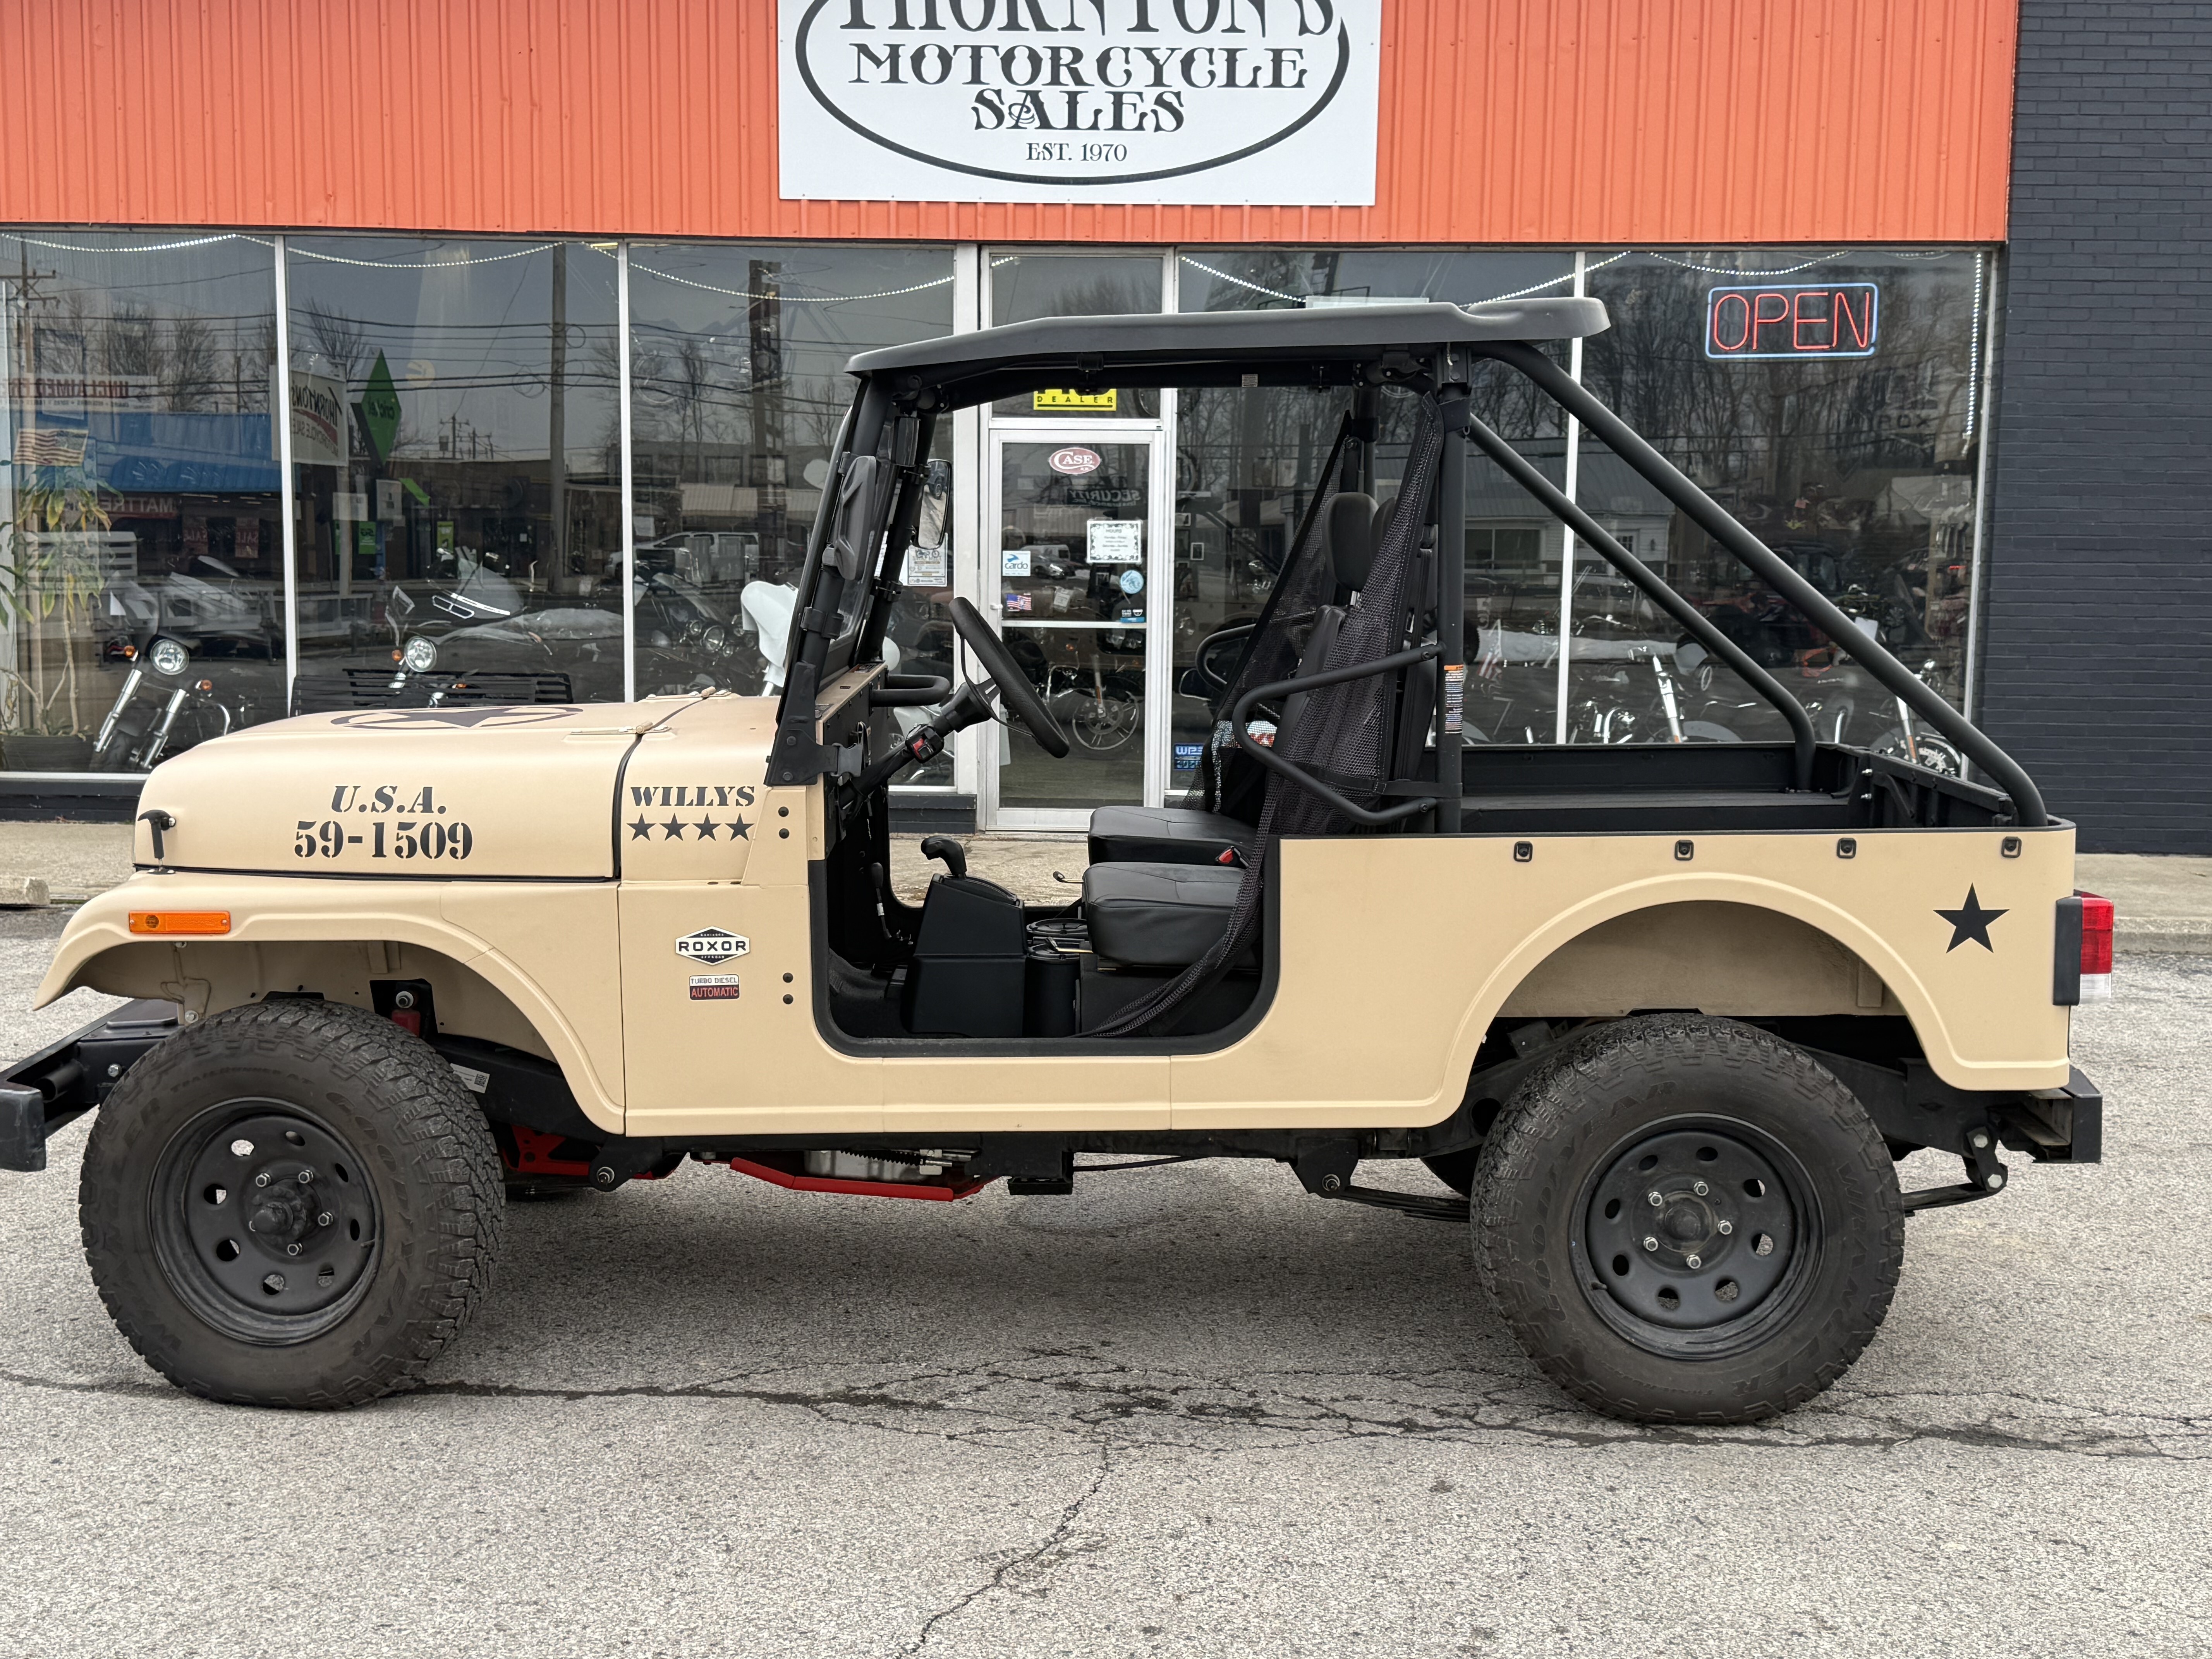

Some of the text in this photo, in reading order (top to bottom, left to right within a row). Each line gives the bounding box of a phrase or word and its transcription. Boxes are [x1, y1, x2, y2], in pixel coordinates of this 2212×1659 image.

[848, 43, 1308, 89] MOTORCYCLE
[974, 88, 1185, 132] SALES
[1025, 143, 1127, 162] EST. 1970
[1713, 292, 1870, 351] OPEN
[1054, 452, 1095, 469] CASE
[331, 785, 447, 814] U.S.A.
[630, 786, 755, 807] WILLYS
[294, 820, 473, 860] 59-1509
[678, 941, 747, 952] ROXOR
[691, 987, 739, 998] AUTOMATIC
